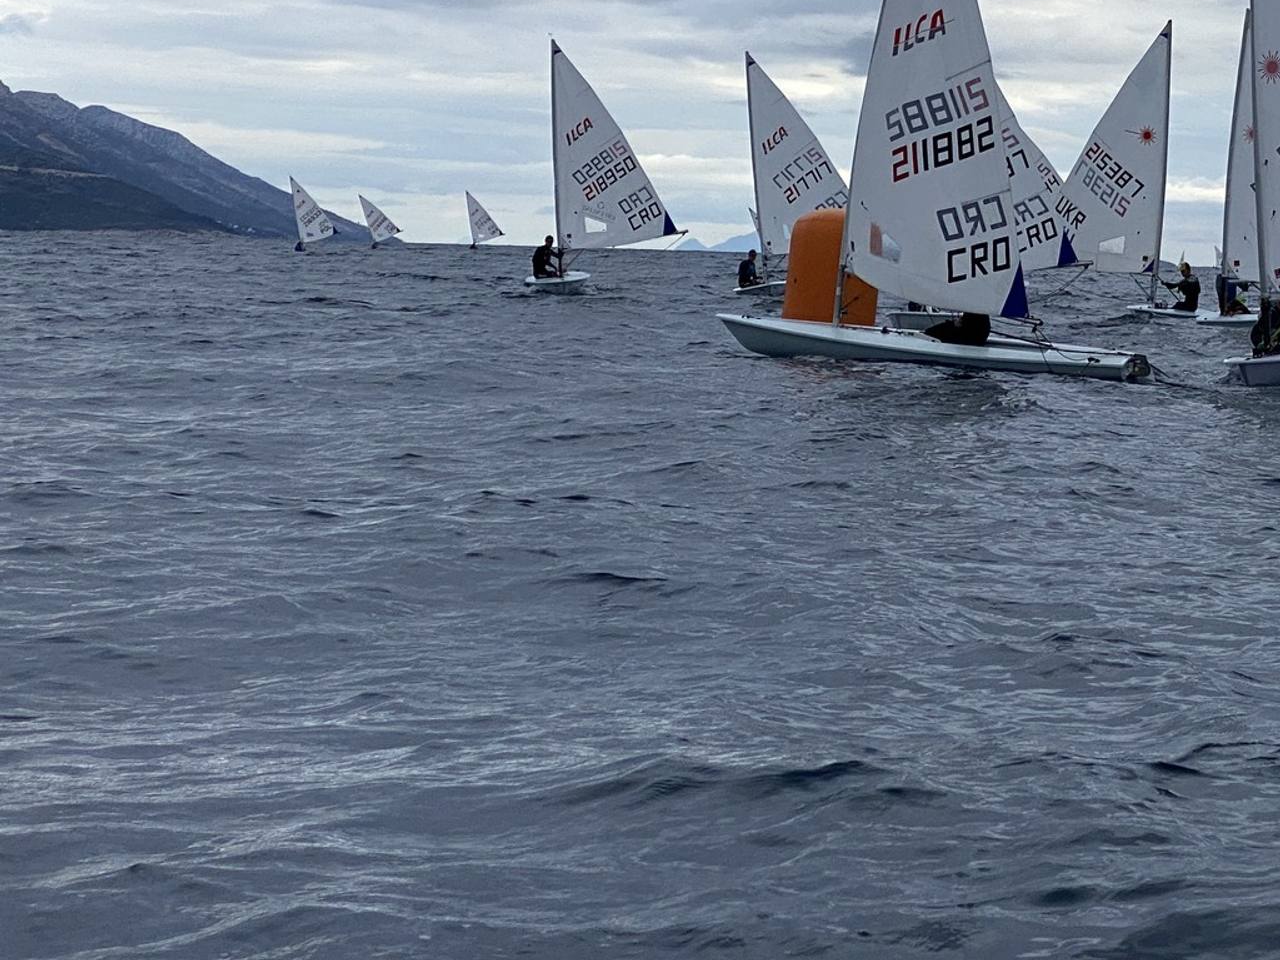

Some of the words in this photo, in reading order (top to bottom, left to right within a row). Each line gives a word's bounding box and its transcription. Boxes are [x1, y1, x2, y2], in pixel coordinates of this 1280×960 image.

[892, 9, 946, 56] ILCA
[565, 117, 594, 146] ILCA
[762, 126, 788, 155] ILCA
[891, 115, 995, 183] 211882
[582, 155, 637, 202] 218950
[784, 161, 832, 204] 217717
[1085, 142, 1145, 198] 215387
[627, 202, 662, 231] CRO
[1055, 195, 1087, 230] UKR
[948, 236, 1011, 283] CRO
